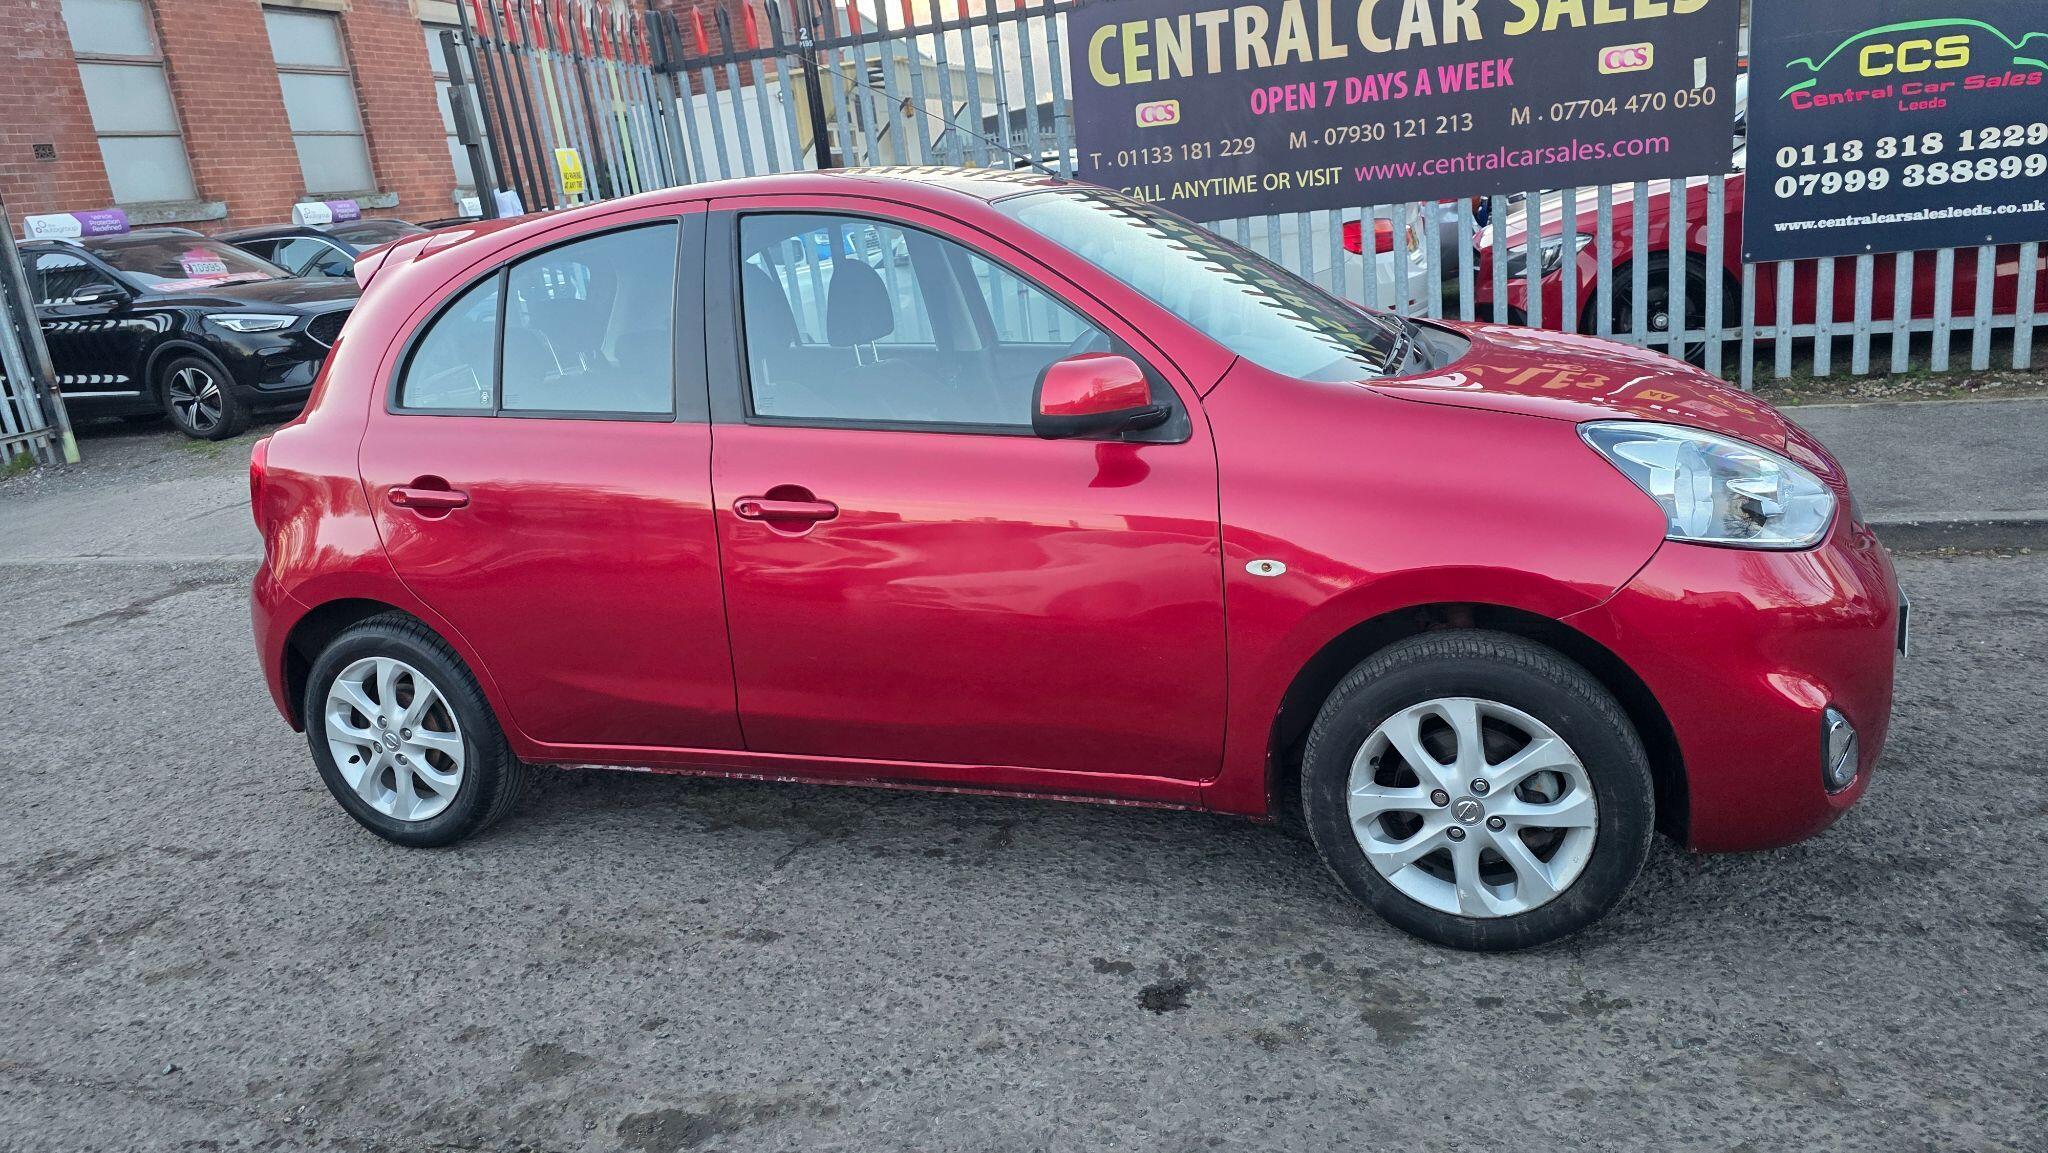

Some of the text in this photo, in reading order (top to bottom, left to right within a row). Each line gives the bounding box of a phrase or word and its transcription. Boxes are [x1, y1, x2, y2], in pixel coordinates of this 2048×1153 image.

[799, 27, 808, 40] 2
[1088, 0, 1710, 87] CENTRAL CAR SAL
[1604, 47, 1648, 70] CCS
[1859, 35, 1970, 77] CCS
[1250, 57, 1514, 115] OPEN 7 DAYS A WEEK
[1790, 71, 2043, 110] Central Car Sales
[1898, 97, 1947, 112] Leeds
[1117, 146, 1173, 167] 01133
[1181, 142, 1212, 160] 181
[1220, 137, 1256, 157] 229
[1324, 123, 1385, 146] 07930
[1393, 119, 1426, 139] 121
[1436, 113, 1473, 135] 213
[1551, 98, 1617, 122] 07704
[1625, 92, 1667, 113] 470
[1673, 86, 1716, 108] 050
[1140, 103, 1176, 124] CCS
[1775, 122, 2048, 168] 0113 318 1229
[1171, 174, 1258, 200] ANYTIME
[1263, 172, 1290, 191] OR
[1296, 166, 1342, 188] VISIT
[1354, 136, 1670, 182] www.centralcarsales.com
[1774, 153, 2048, 198] 07999 388899
[1774, 199, 2046, 232] www.centralcarsalesleeds.co.uk
